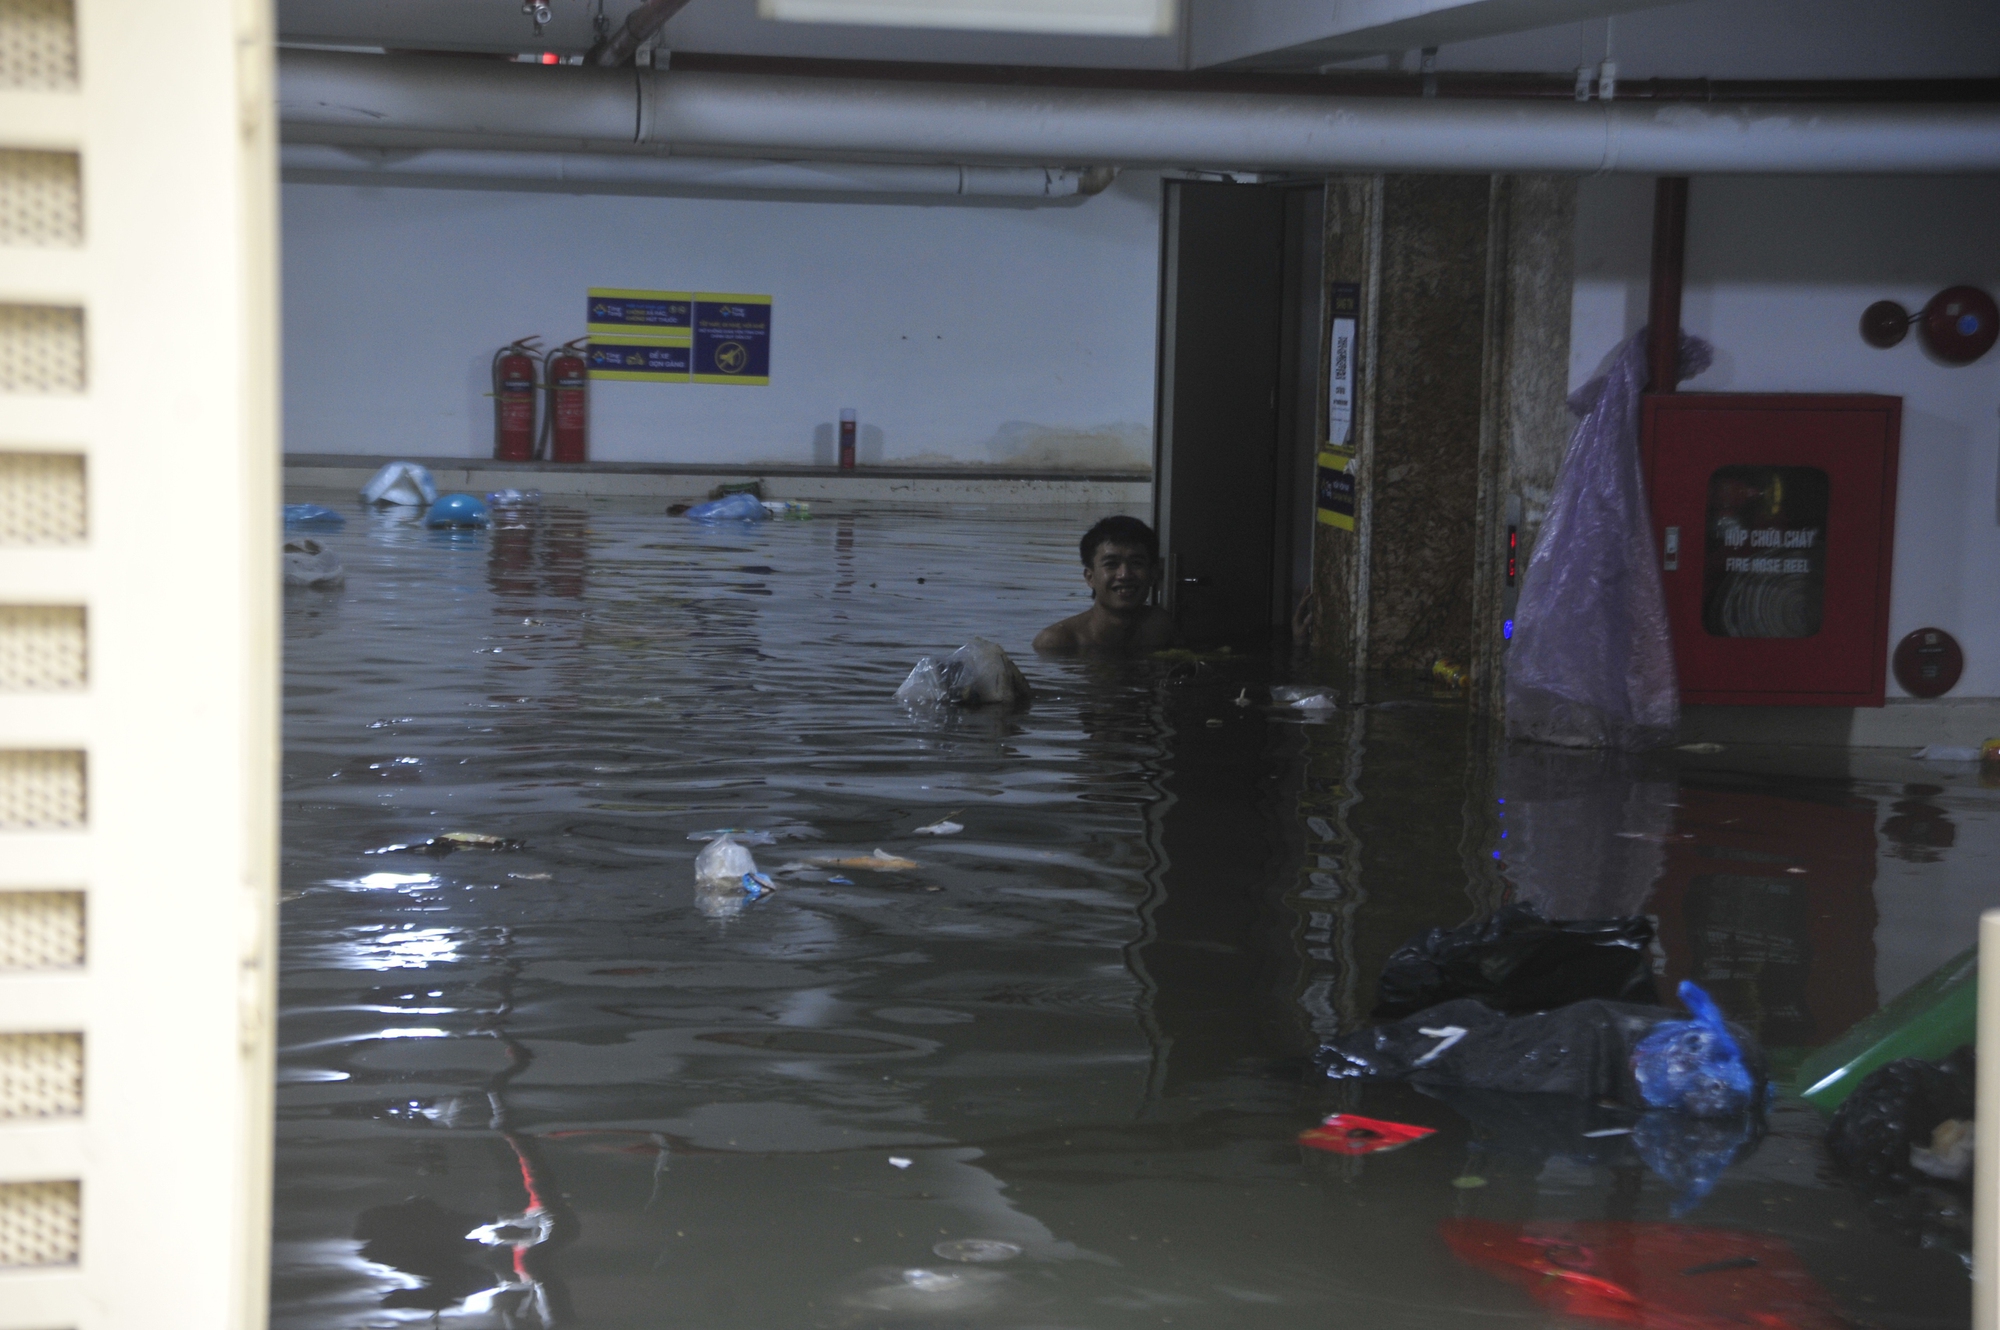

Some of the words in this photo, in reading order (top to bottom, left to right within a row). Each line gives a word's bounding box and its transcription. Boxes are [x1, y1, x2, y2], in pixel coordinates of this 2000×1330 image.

[1724, 526, 1748, 550] HỘP
[1750, 527, 1780, 547] CHỮA
[1783, 528, 1815, 548] CHÁY
[1725, 558, 1750, 572] FIRE
[1752, 558, 1781, 572] HOSE
[1783, 559, 1809, 573] REEL
